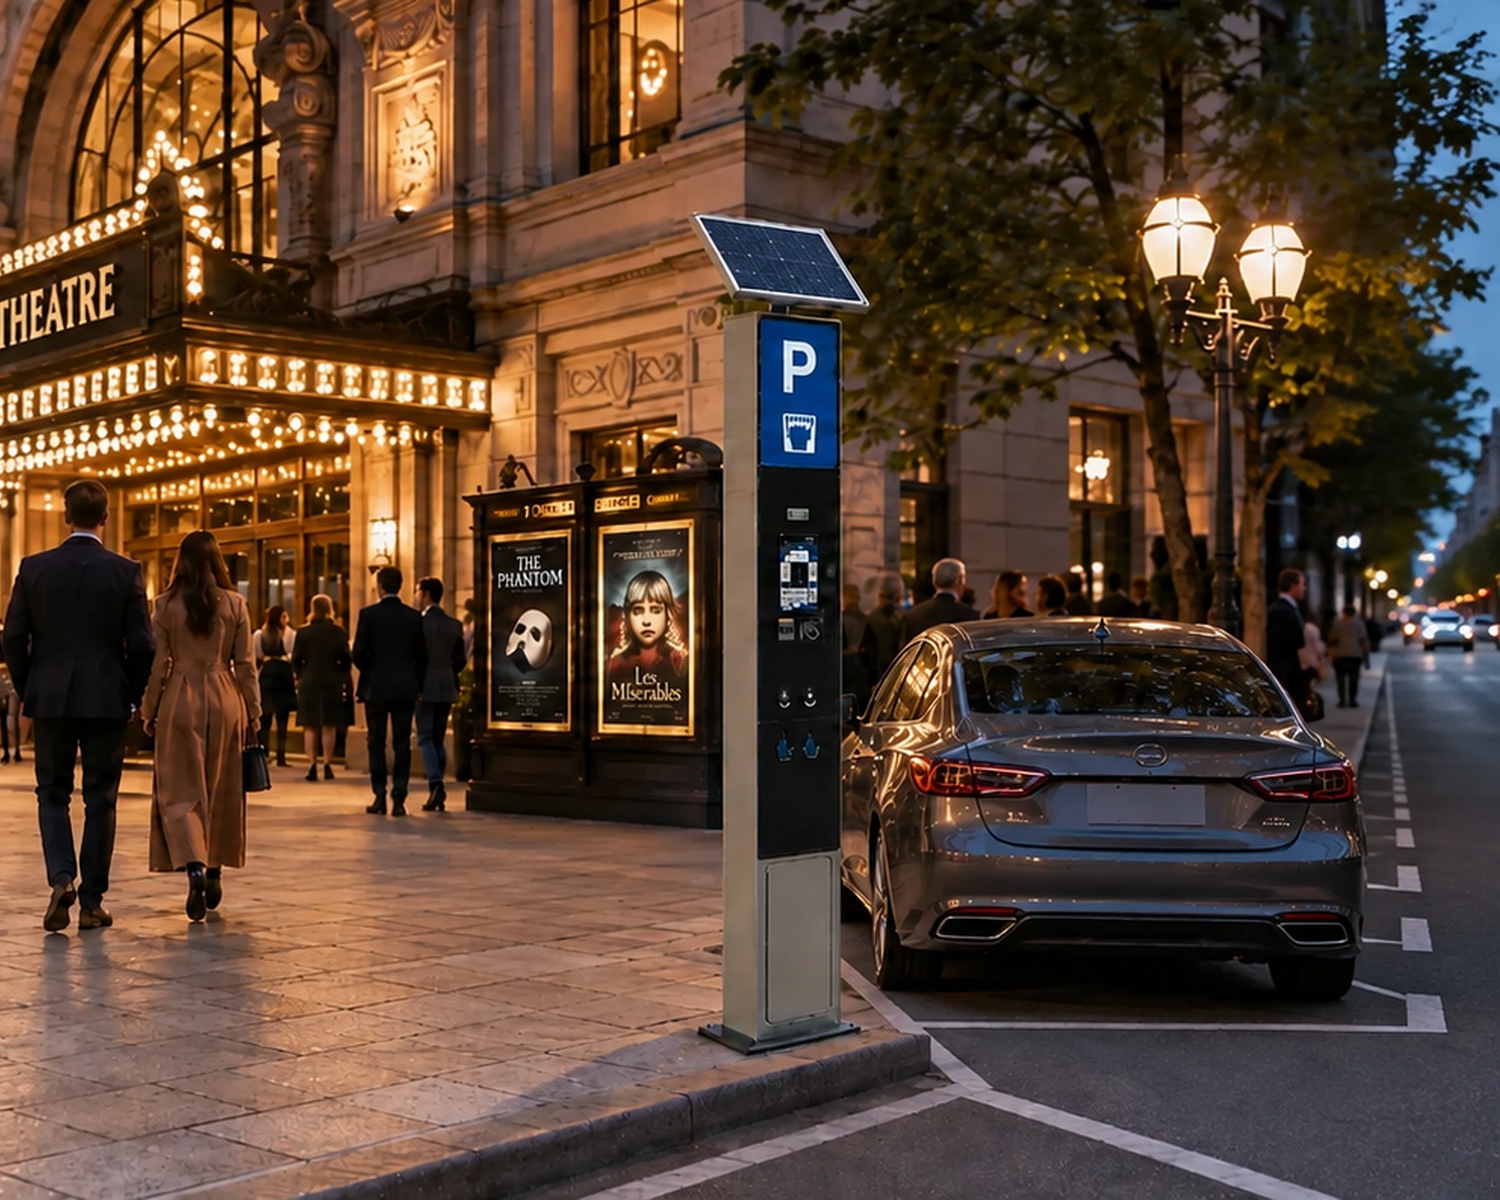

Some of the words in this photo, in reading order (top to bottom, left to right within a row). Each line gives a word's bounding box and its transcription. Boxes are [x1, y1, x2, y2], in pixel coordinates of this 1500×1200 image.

[783, 339, 817, 393] P
[516, 555, 542, 571] THE
[497, 568, 563, 589] PHANTOM
[635, 666, 658, 686] Les
